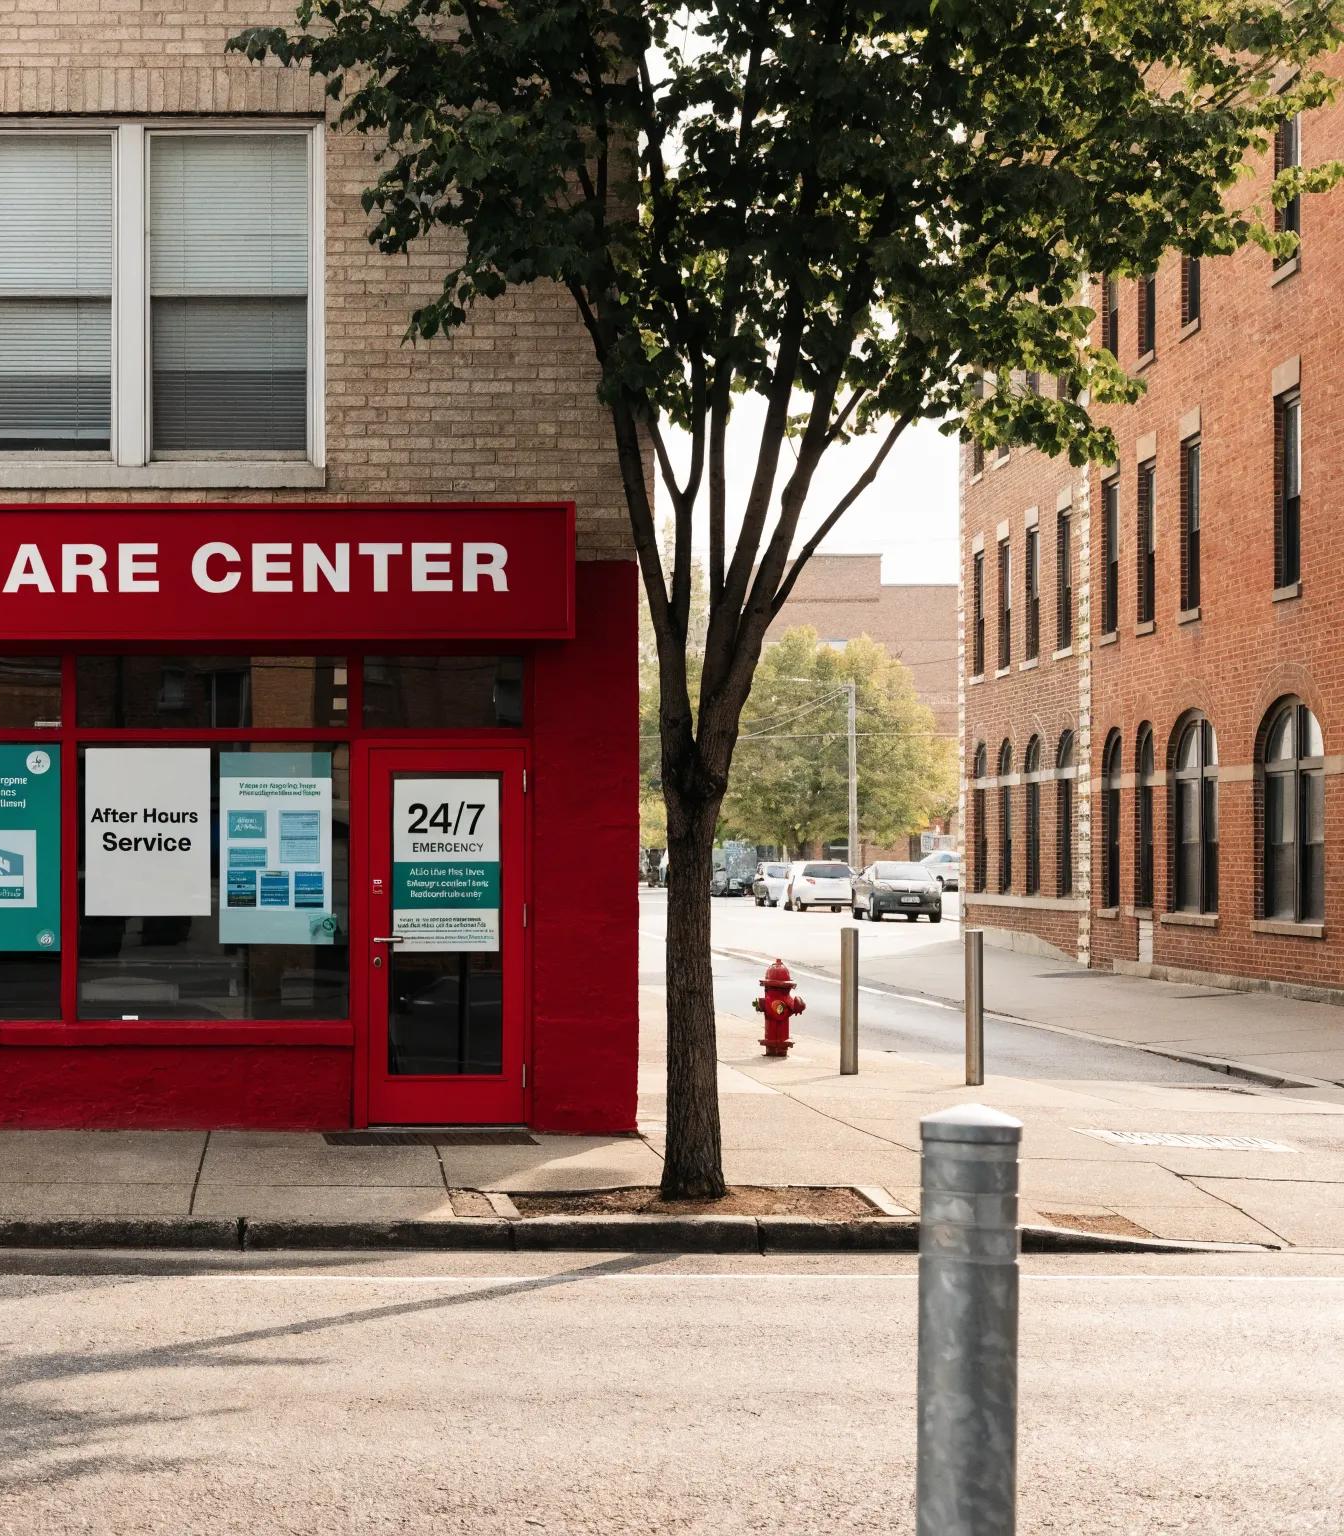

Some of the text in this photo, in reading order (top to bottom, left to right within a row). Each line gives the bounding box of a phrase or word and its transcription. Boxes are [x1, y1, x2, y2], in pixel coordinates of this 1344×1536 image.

[191, 541, 510, 594] CENTER
[90, 807, 199, 824] After Hours
[407, 800, 486, 836] 24/7
[102, 831, 192, 852] Service
[412, 842, 484, 853] EMERGENCY
